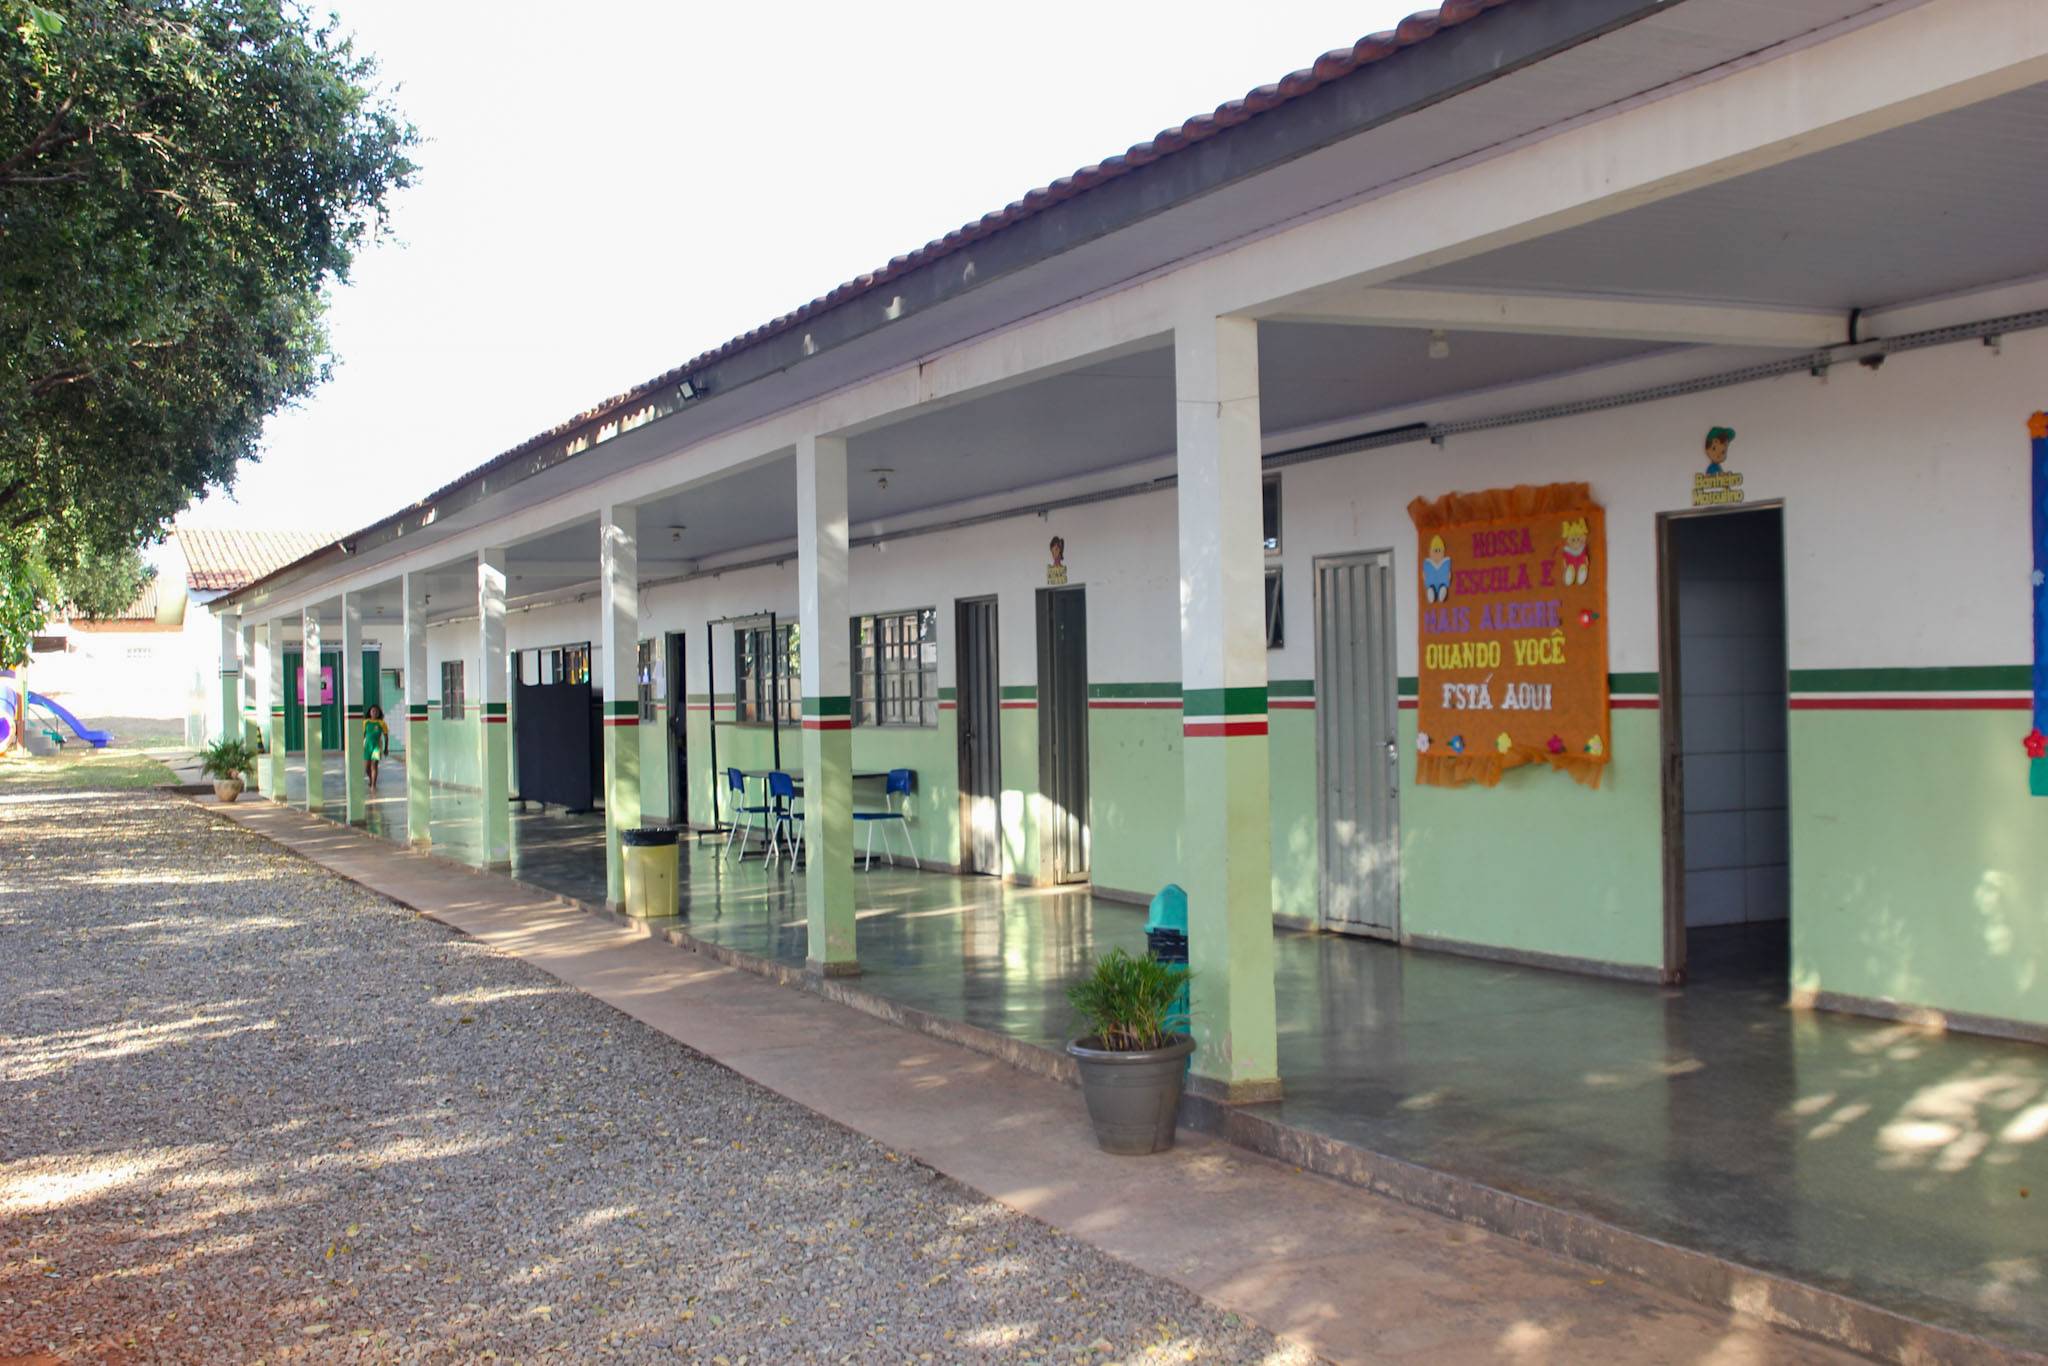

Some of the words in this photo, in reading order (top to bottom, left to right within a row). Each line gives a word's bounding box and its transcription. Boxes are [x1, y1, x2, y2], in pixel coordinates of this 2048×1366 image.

[1472, 528, 1534, 559] NOSSA
[1455, 563, 1532, 595] ESCOLA
[1424, 607, 1471, 634] MAIS
[1479, 599, 1562, 631] ALEGRE
[1514, 629, 1566, 666] VOCÊ
